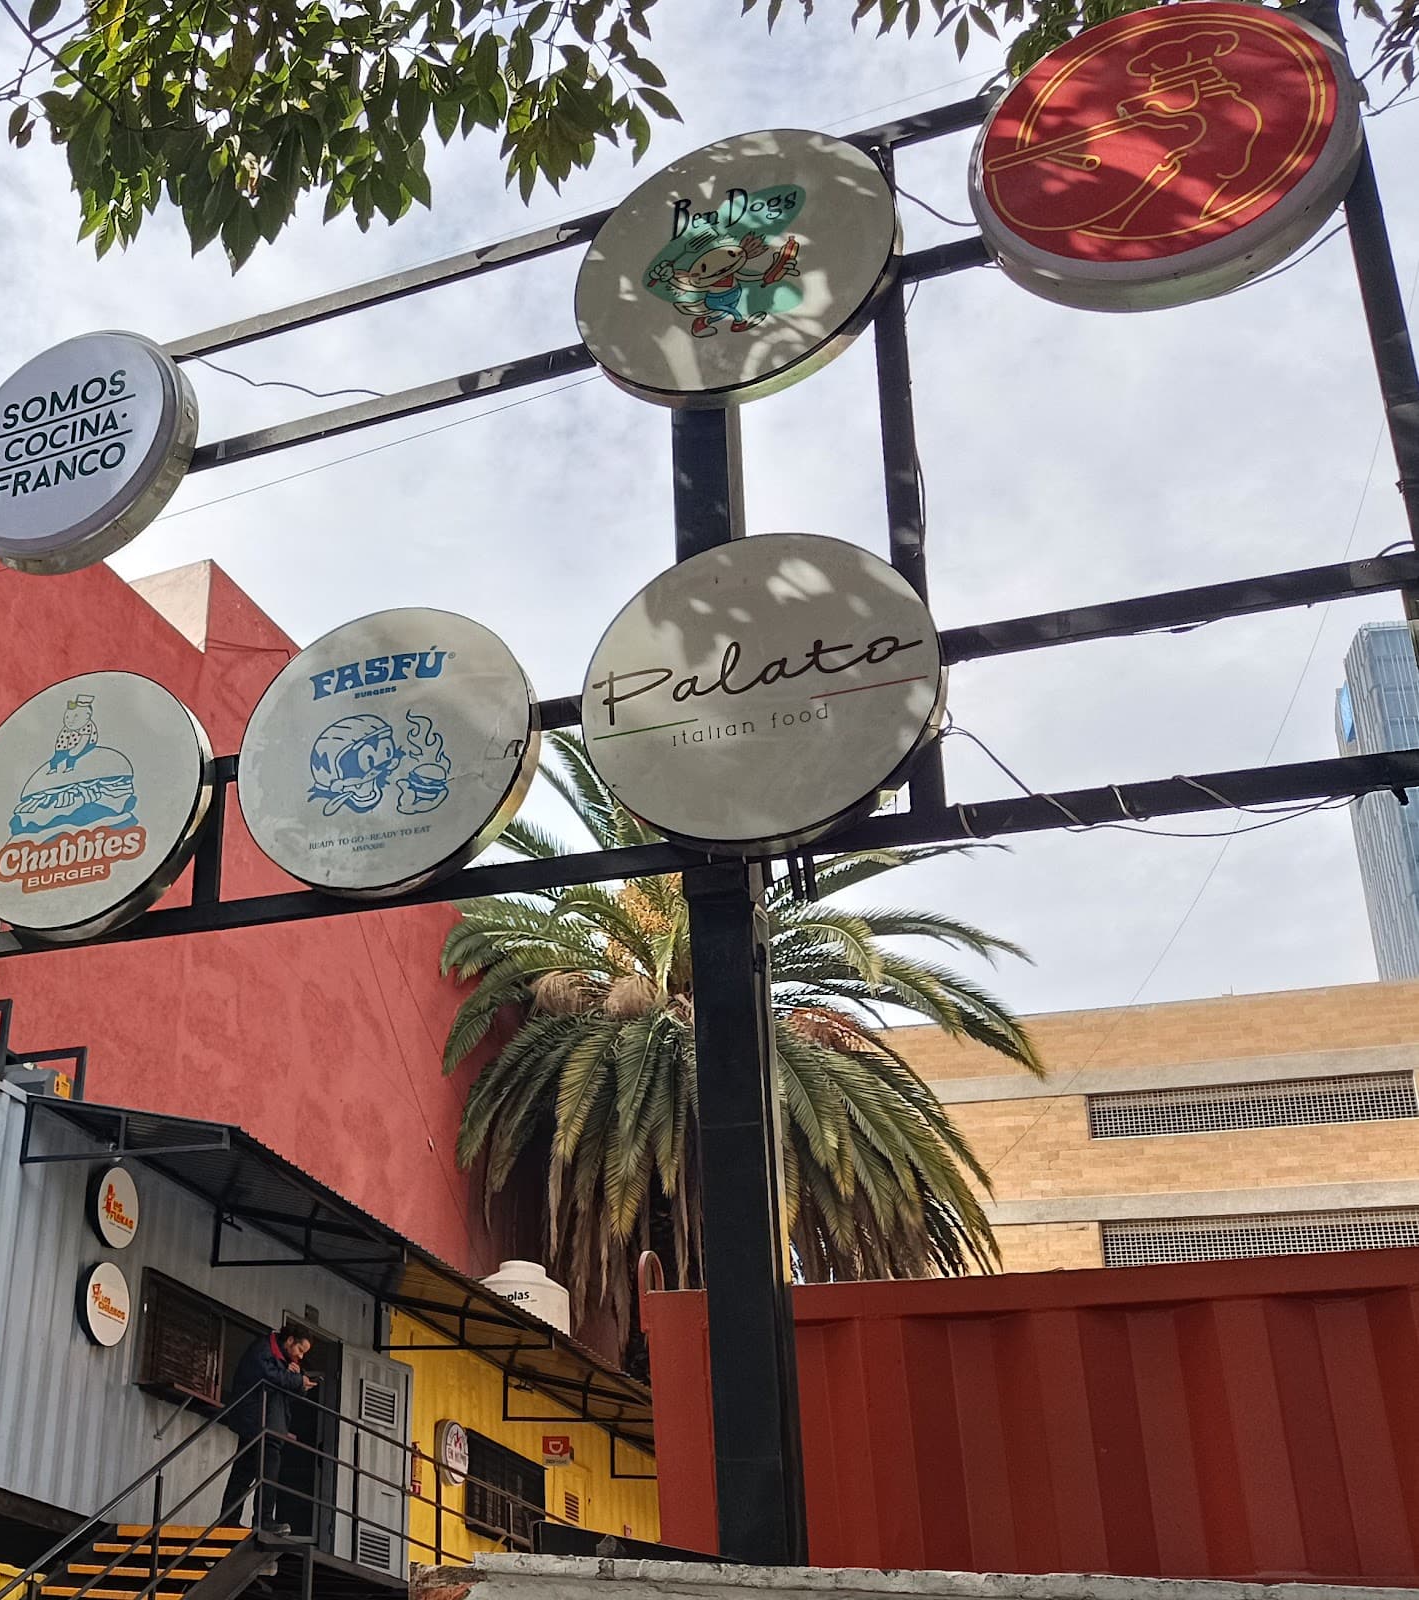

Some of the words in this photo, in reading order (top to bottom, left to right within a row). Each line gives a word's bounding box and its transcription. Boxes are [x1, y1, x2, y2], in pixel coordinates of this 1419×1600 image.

[671, 198, 719, 240] Ben
[727, 187, 797, 227] Dogs
[2, 369, 127, 430] SOMOS
[309, 645, 447, 700] FASFÚ
[354, 685, 397, 699] BURGERS
[592, 636, 924, 726] Palato
[672, 720, 755, 747] italian
[771, 703, 829, 729] food
[0, 831, 141, 876] Chubbies
[309, 840, 334, 850] READY
[338, 838, 349, 846] TO
[351, 835, 364, 843] GO
[370, 830, 398, 841] READY
[400, 828, 412, 836] TO
[414, 825, 431, 834] EAT
[27, 865, 105, 888] BURGER
